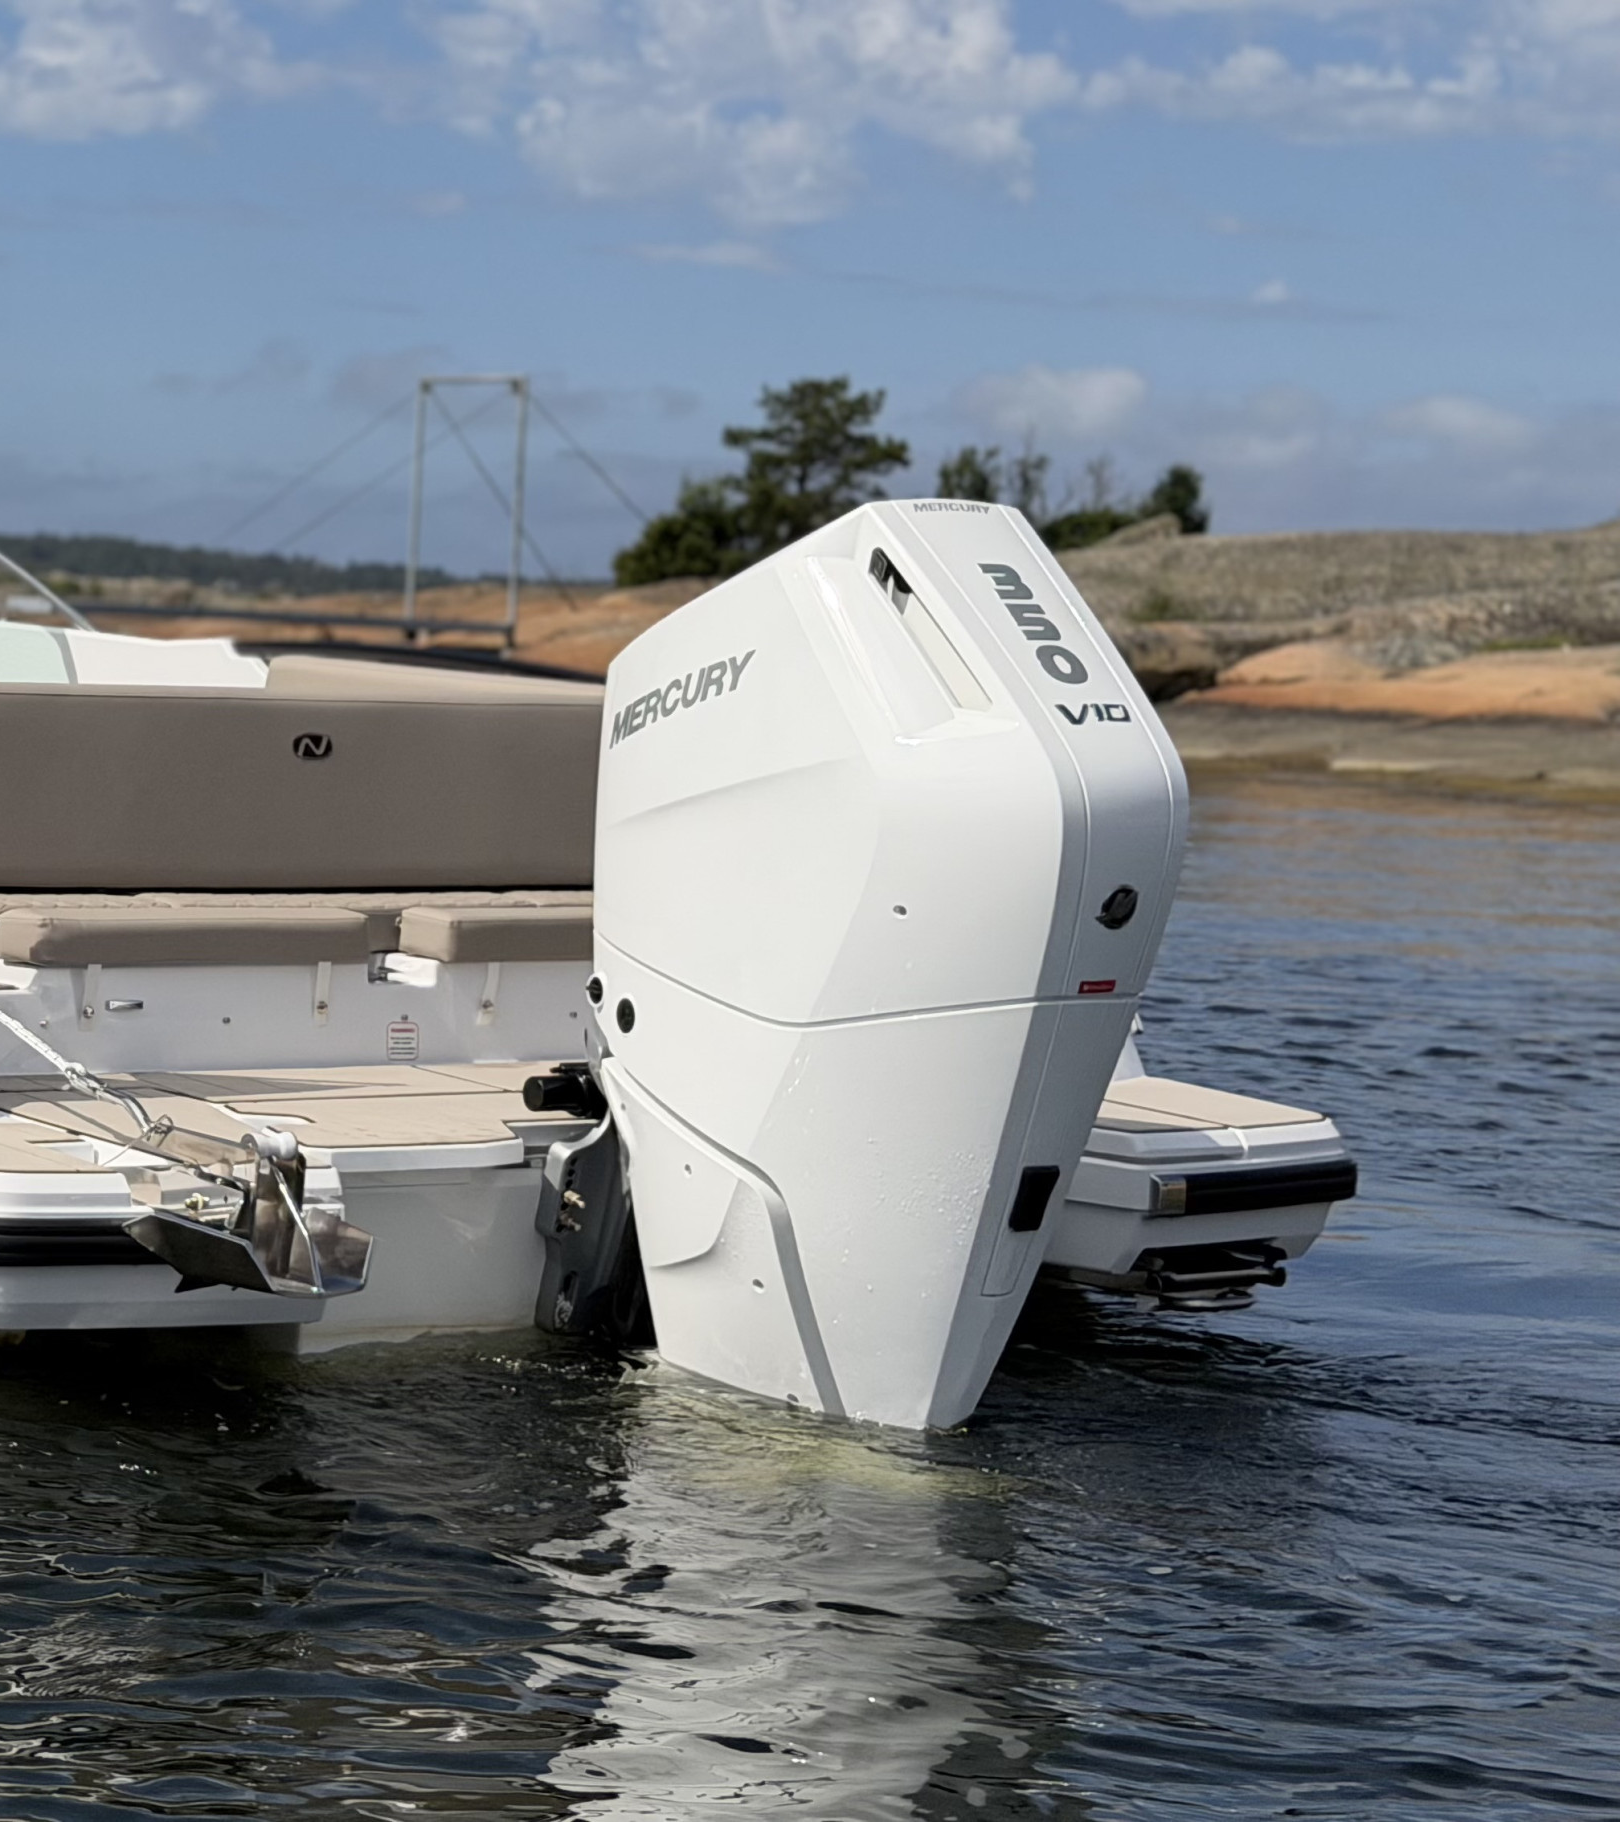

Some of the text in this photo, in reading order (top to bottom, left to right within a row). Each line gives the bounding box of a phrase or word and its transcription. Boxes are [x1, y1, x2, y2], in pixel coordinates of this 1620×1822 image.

[913, 502, 990, 515] MERCURY
[977, 562, 1089, 685] 350
[609, 649, 757, 750] MERCURY
[1054, 703, 1132, 726] V10
